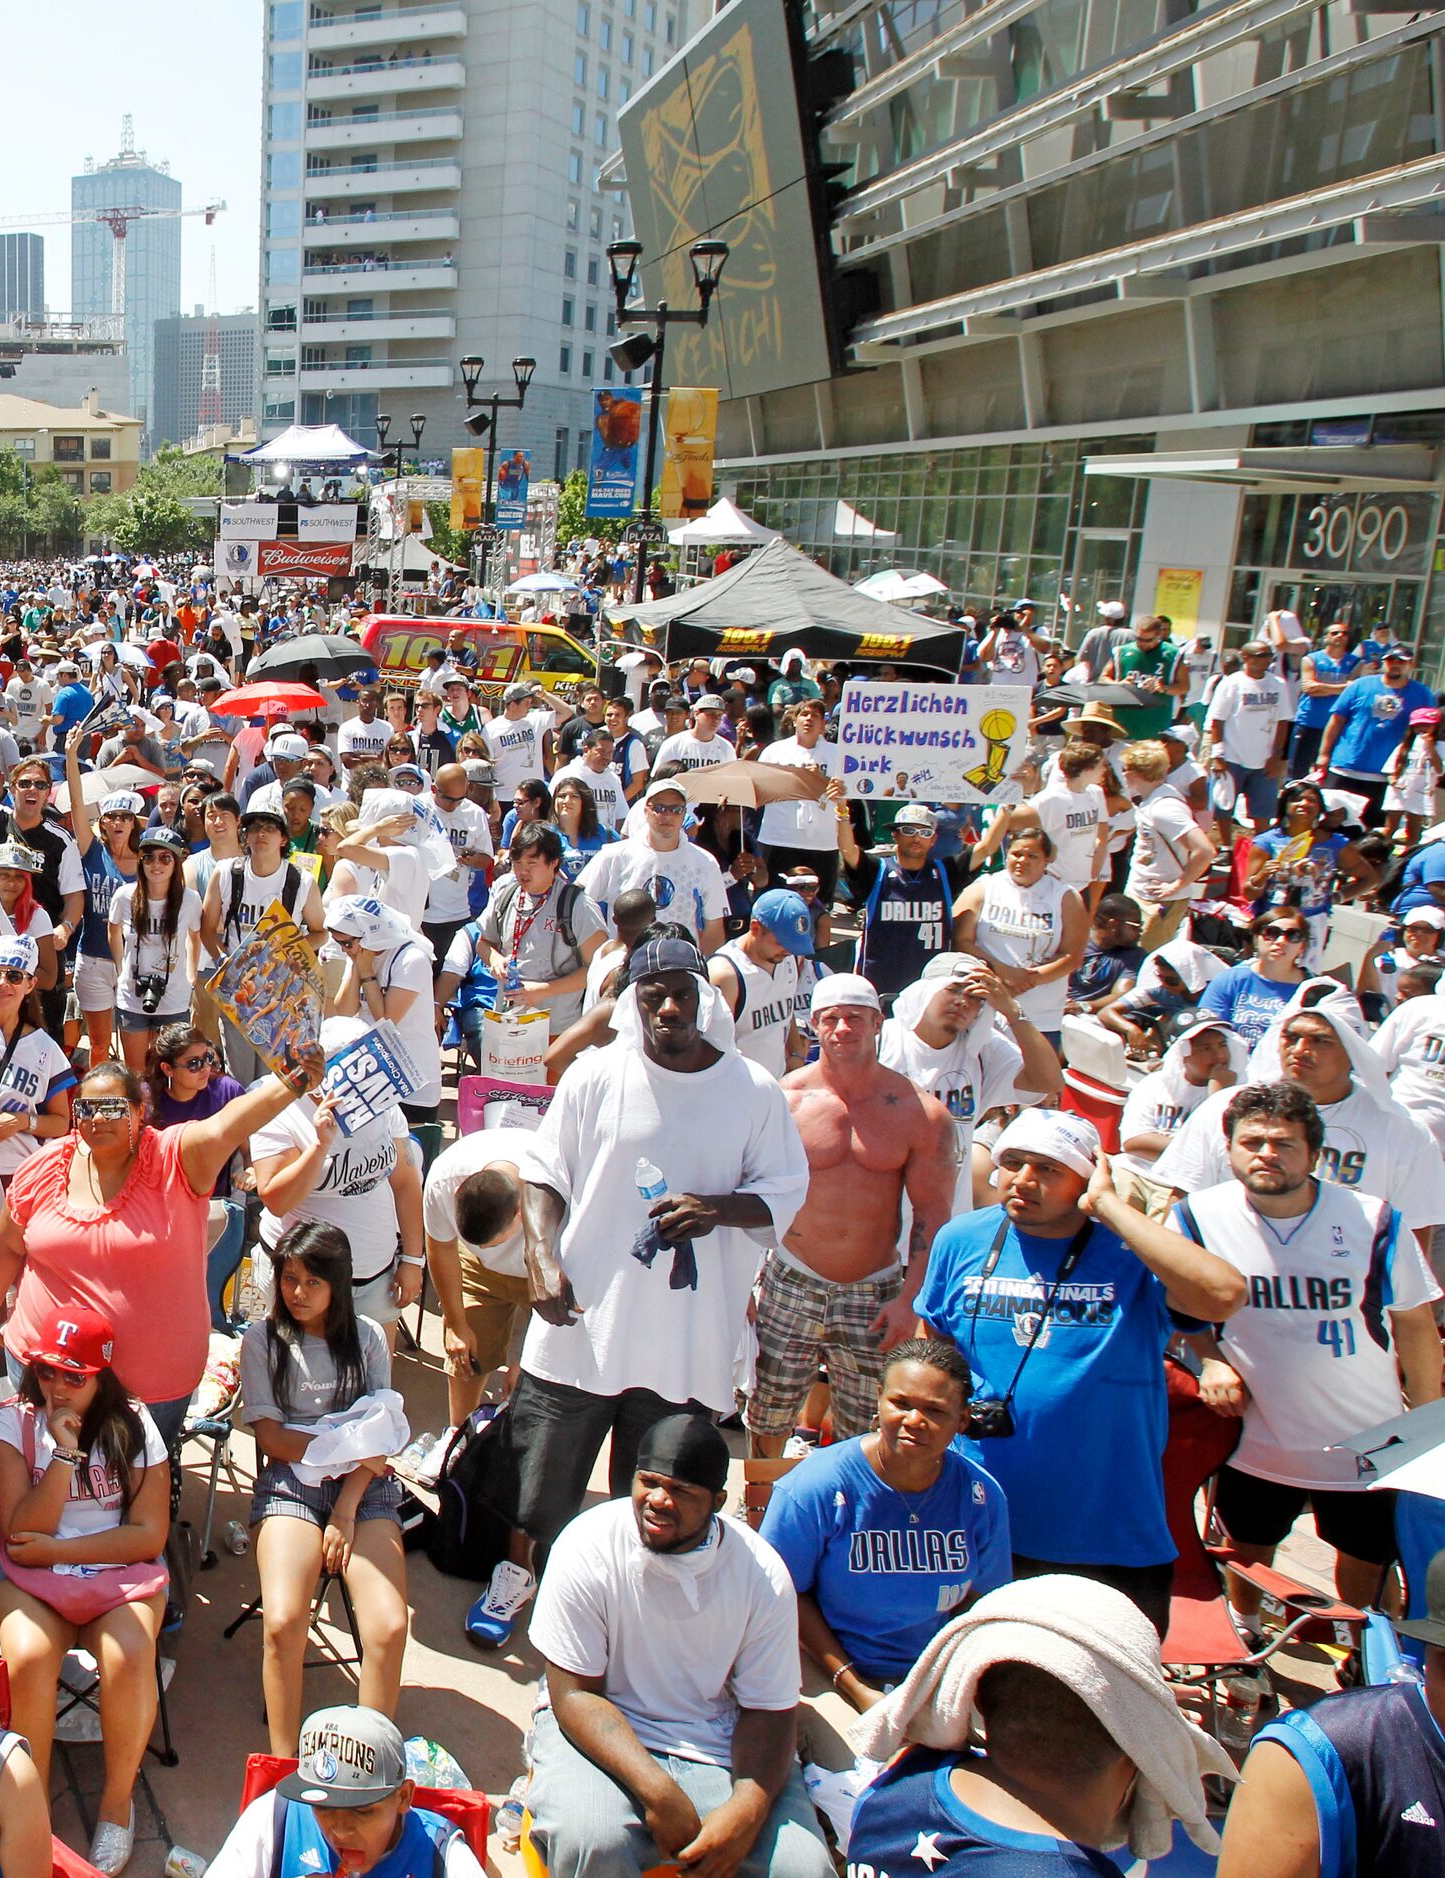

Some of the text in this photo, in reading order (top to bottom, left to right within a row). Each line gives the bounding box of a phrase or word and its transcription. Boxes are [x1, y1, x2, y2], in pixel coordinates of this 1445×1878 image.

[674, 297, 783, 384] KENICHI
[232, 517, 275, 526] SOUTHWEST
[310, 519, 354, 528] SOUTHWEST
[1302, 505, 1409, 561] 3090
[261, 548, 348, 567] Budweiser
[382, 636, 525, 680] 10.1
[1154, 662, 1164, 677] 2
[846, 690, 967, 715] Herzlichen
[1242, 692, 1279, 705] DALLAS
[353, 737, 384, 751] DALLAS
[499, 728, 535, 747] DALLAS
[842, 722, 976, 748] Glückwunsch
[843, 755, 892, 774] Dirk
[594, 788, 617, 803] LLAS
[881, 901, 943, 921] DALLAS
[988, 904, 1053, 930] DALLAS
[917, 922, 943, 949] 41
[370, 1036, 411, 1096] NBA Champions
[488, 1052, 543, 1068] briefing
[339, 1044, 403, 1116] AVS!
[1051, 1284, 1114, 1302] FINALS
[1245, 1276, 1352, 1311] ALLAS
[57, 1320, 78, 1346] T
[1317, 1318, 1355, 1358] 41
[849, 1528, 969, 1574] DALLAS
[325, 1723, 339, 1731] NBA
[302, 1731, 376, 1776] CHAMPIONS
[1400, 1811, 1436, 1827] adidas
